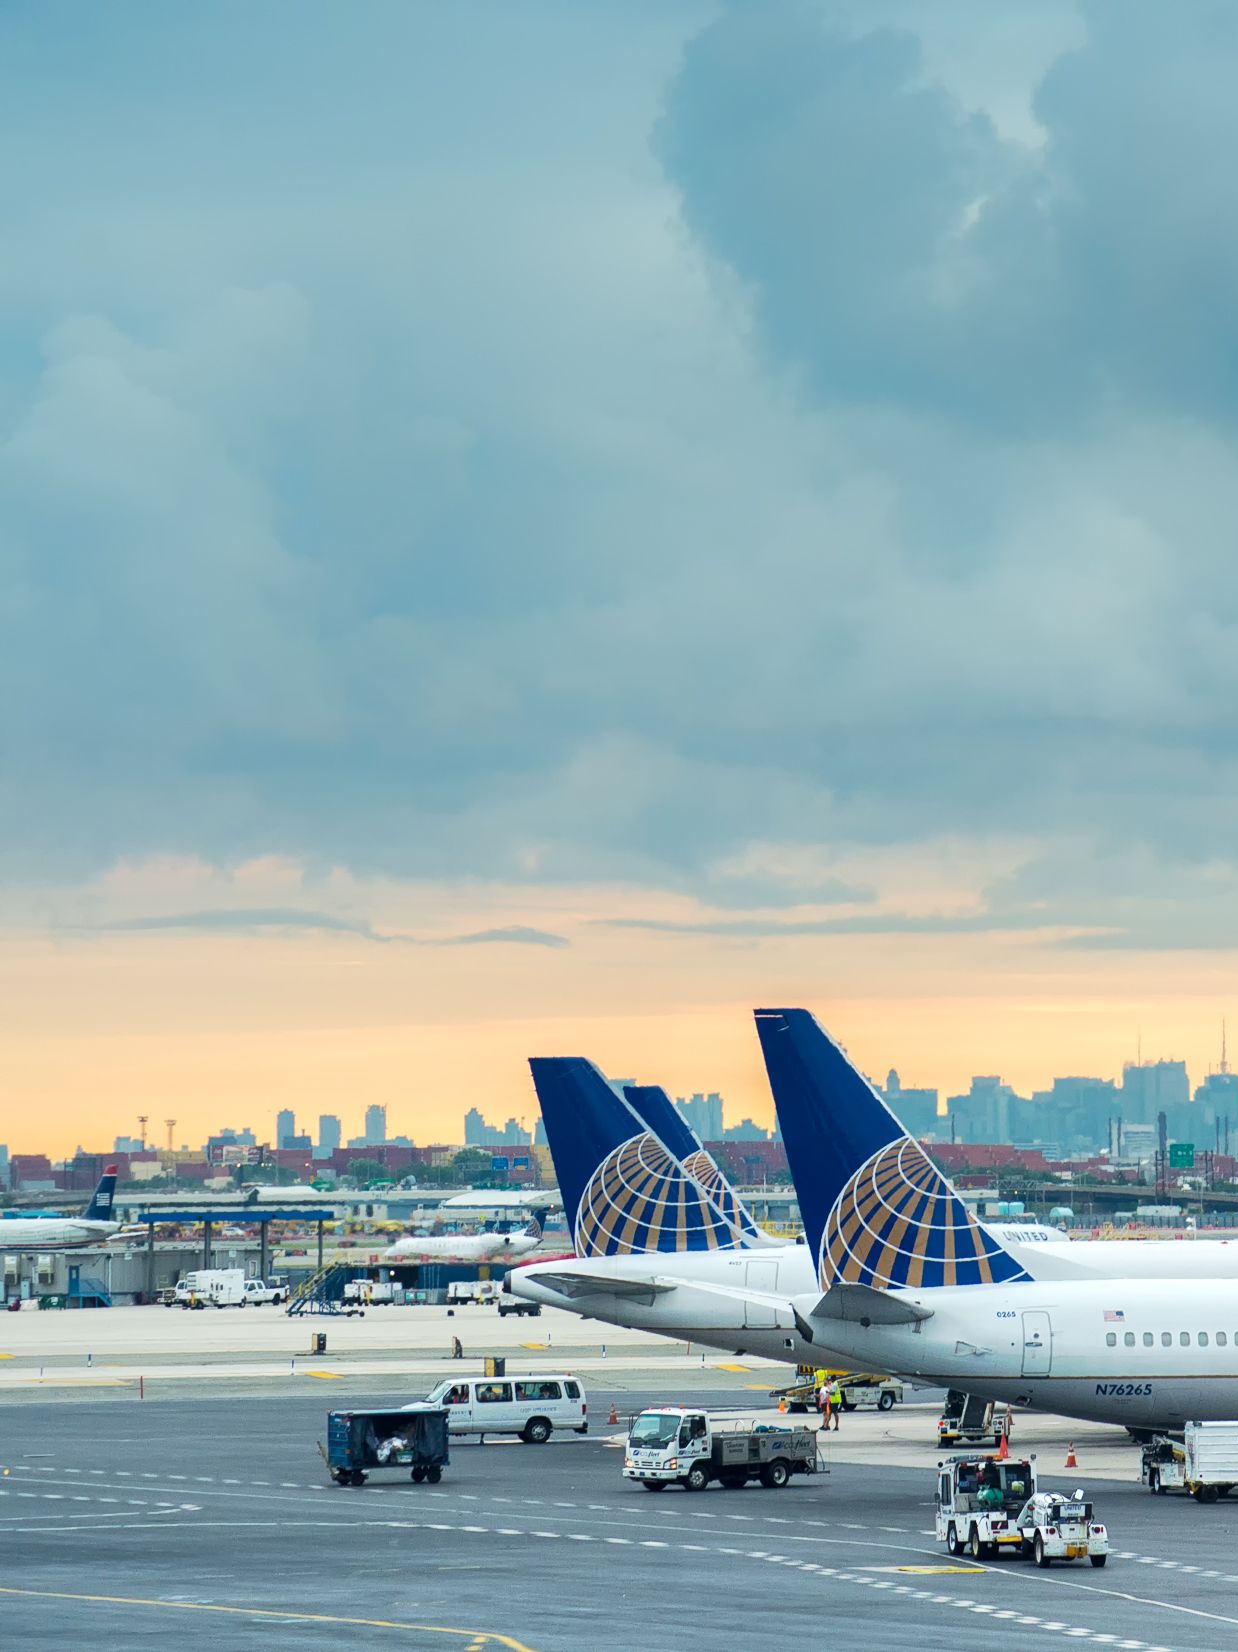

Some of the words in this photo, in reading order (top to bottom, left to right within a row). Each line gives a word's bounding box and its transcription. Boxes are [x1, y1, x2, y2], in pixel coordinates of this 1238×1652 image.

[1002, 1231, 1048, 1241] UNITED
[996, 1311, 1017, 1319] 0265
[1095, 1383, 1153, 1396] N76265
